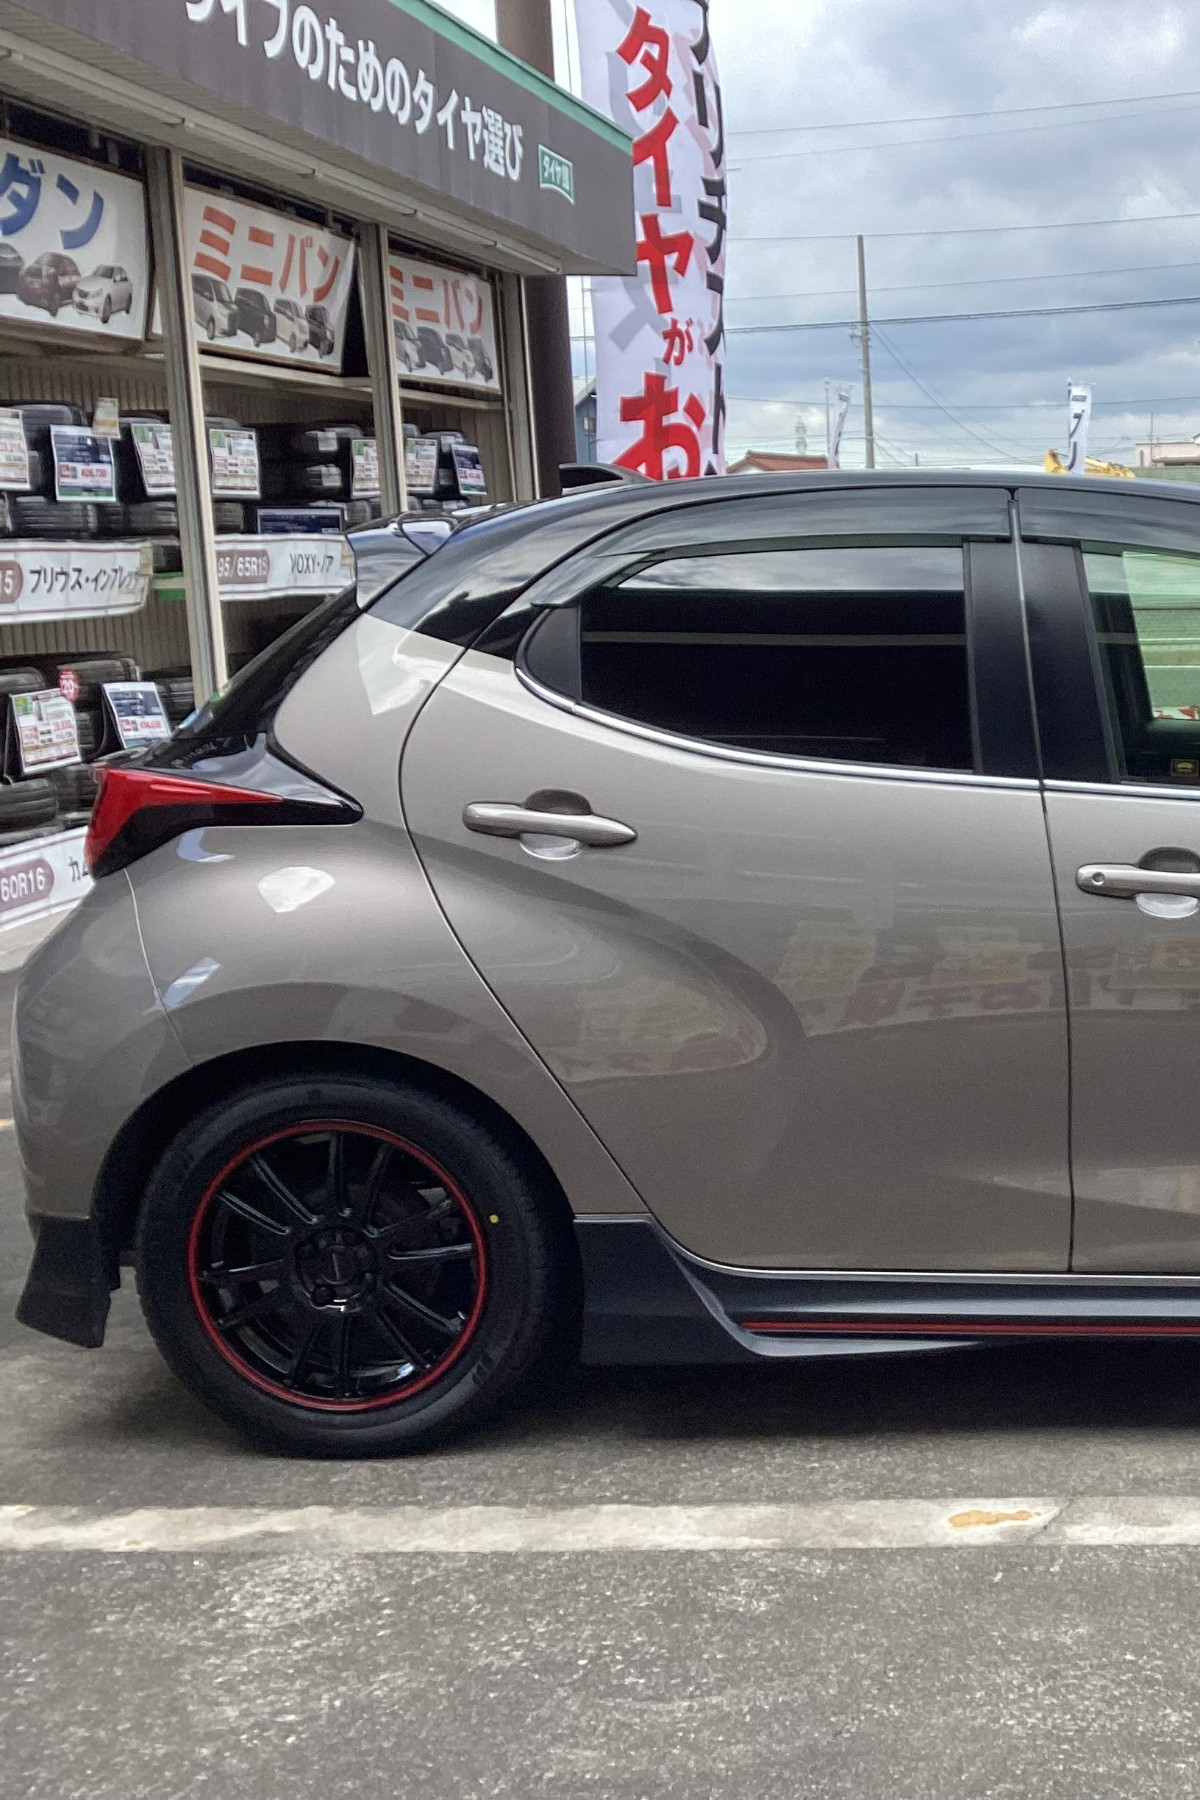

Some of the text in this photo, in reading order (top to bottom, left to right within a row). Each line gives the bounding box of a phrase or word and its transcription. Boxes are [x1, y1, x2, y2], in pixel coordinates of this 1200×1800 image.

[186, 0, 524, 181] イフのためのタイヤ選び
[0, 152, 105, 250] ダン
[615, 5, 706, 482] タイヤがお
[193, 205, 341, 302] ミニバン
[389, 264, 483, 335] ミニバン
[0, 569, 13, 595] 5
